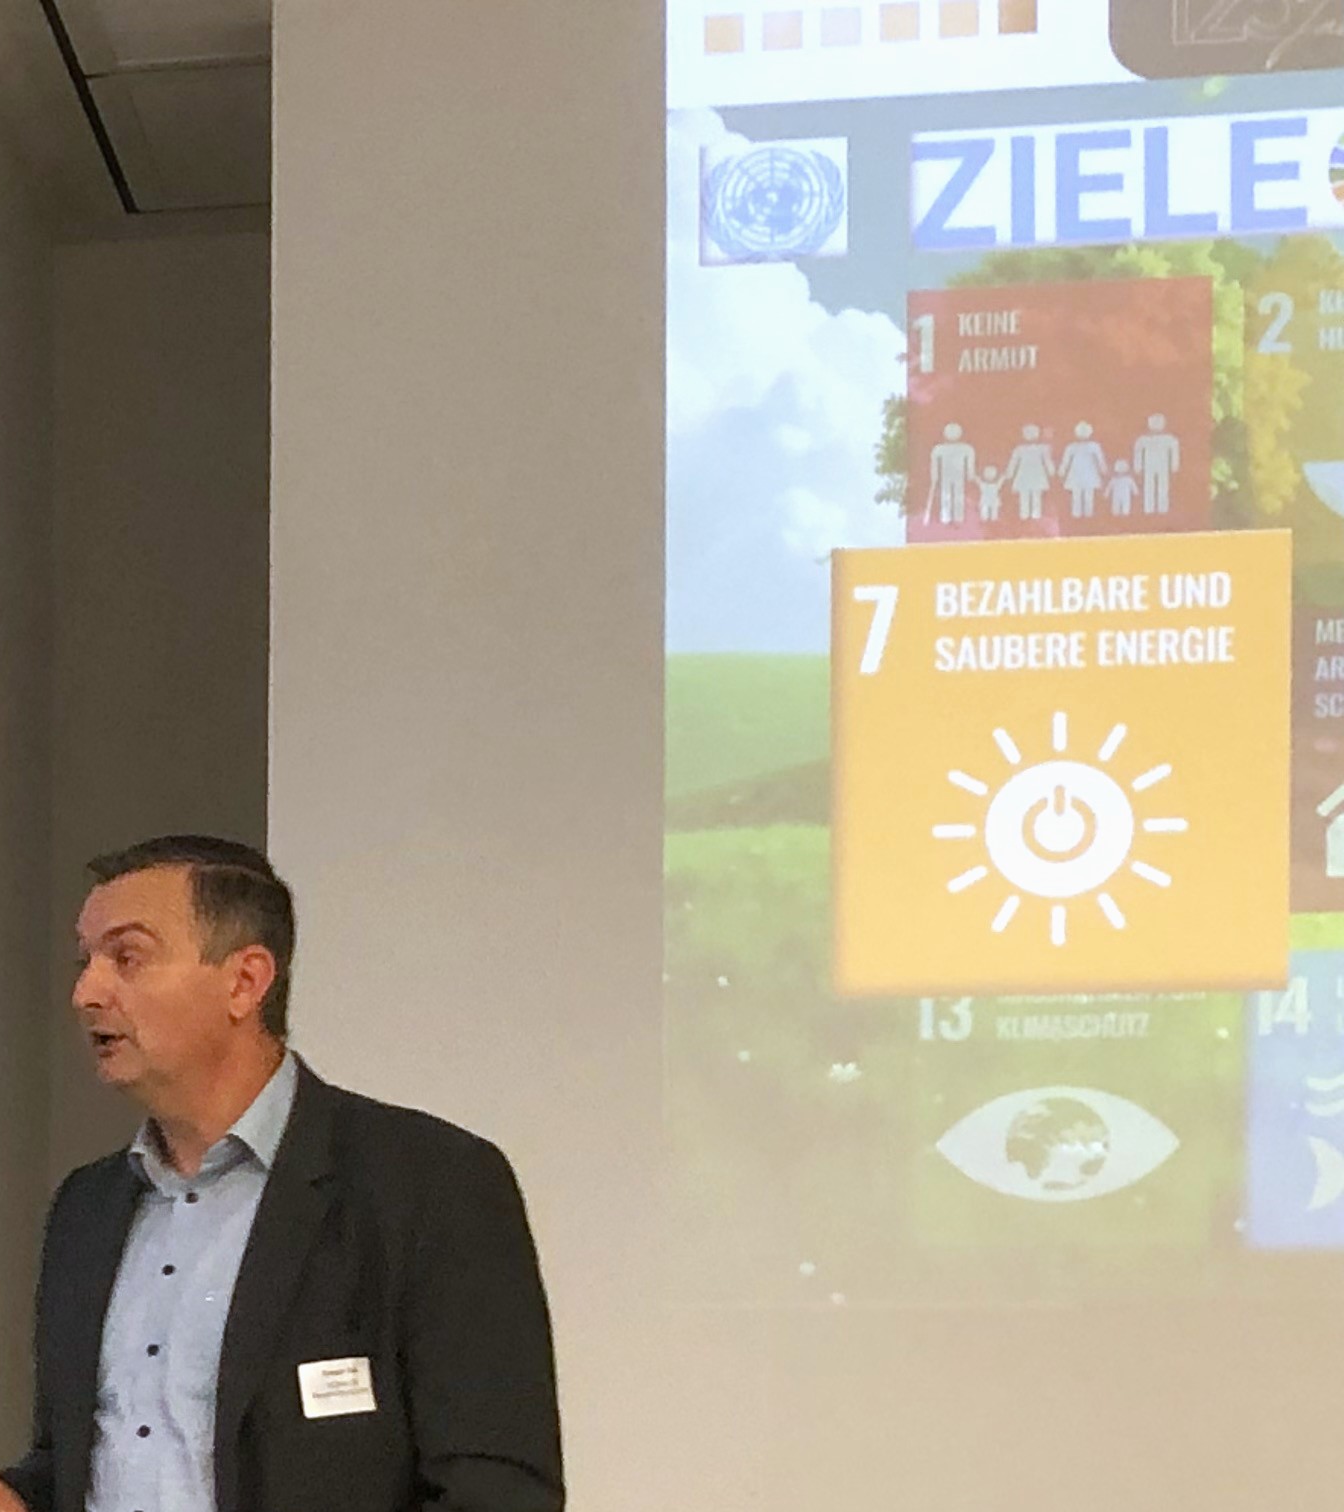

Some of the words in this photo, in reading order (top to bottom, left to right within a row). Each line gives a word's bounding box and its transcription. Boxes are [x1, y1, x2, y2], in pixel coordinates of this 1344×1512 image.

[914, 117, 1308, 249] ZIELE
[914, 314, 934, 374] 1
[958, 310, 1021, 337] KEINE
[1257, 291, 1293, 353] 2
[958, 344, 1038, 375] ARMUT
[935, 574, 1149, 618] BEZAHLBARE
[1159, 571, 1231, 609] UND
[853, 584, 899, 675] 7
[935, 631, 1086, 671] SAUBERE
[1097, 625, 1235, 666] ENERGIE
[1257, 975, 1312, 1036] 14
